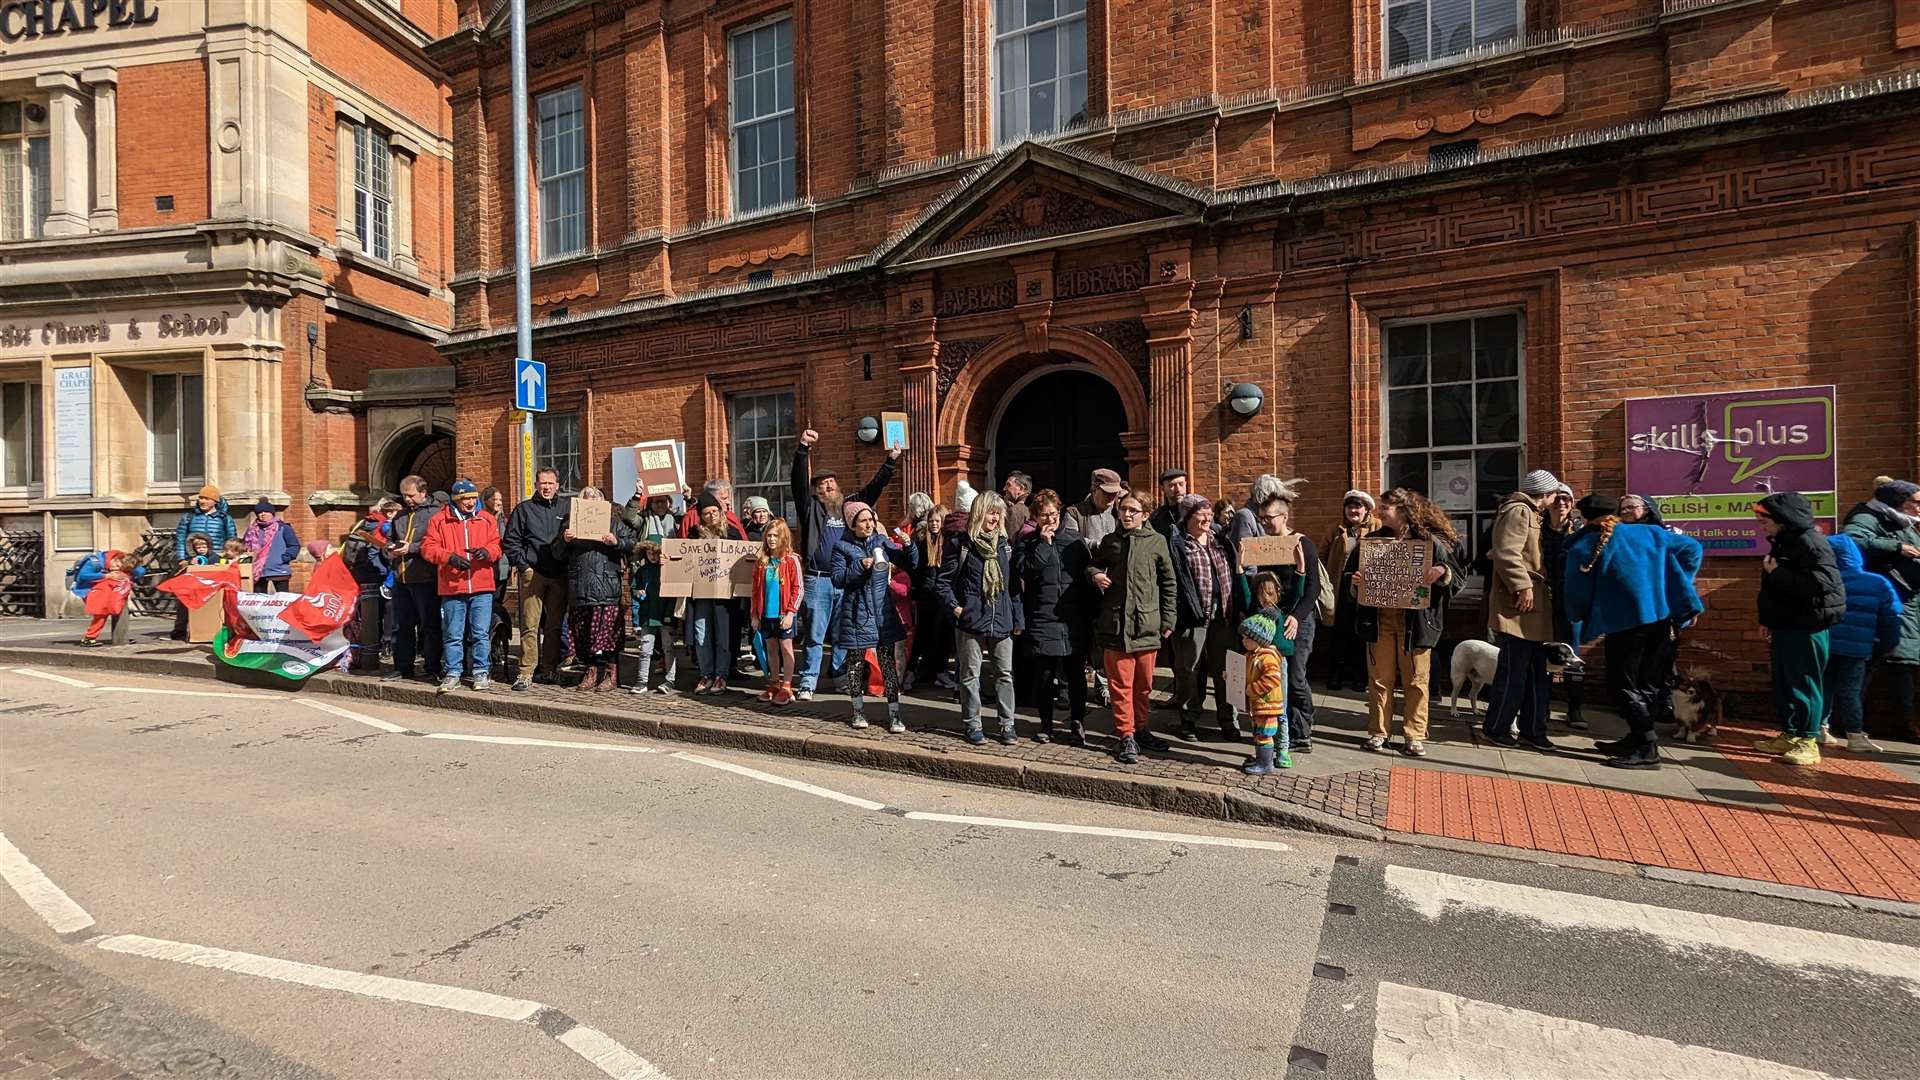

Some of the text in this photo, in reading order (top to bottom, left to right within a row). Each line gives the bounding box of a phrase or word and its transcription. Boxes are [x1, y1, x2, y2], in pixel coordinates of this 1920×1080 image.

[0, 0, 159, 39] CHAPEL
[1056, 261, 1146, 297] LIBRARY
[41, 319, 110, 345] Church
[127, 317, 142, 340] &
[158, 311, 230, 339] School
[1630, 420, 1809, 454] skills plus
[1703, 528, 1724, 537] talk
[1727, 527, 1738, 537] to
[680, 542, 701, 555] SAVE
[720, 541, 761, 556] LIBRARY
[1364, 551, 1410, 560] LIBRARIES
[1365, 559, 1396, 567] DURING
[1365, 566, 1423, 576] RECESSION IS
[1364, 574, 1424, 584] LIKE CUTTING
[1365, 588, 1398, 598] DURING
